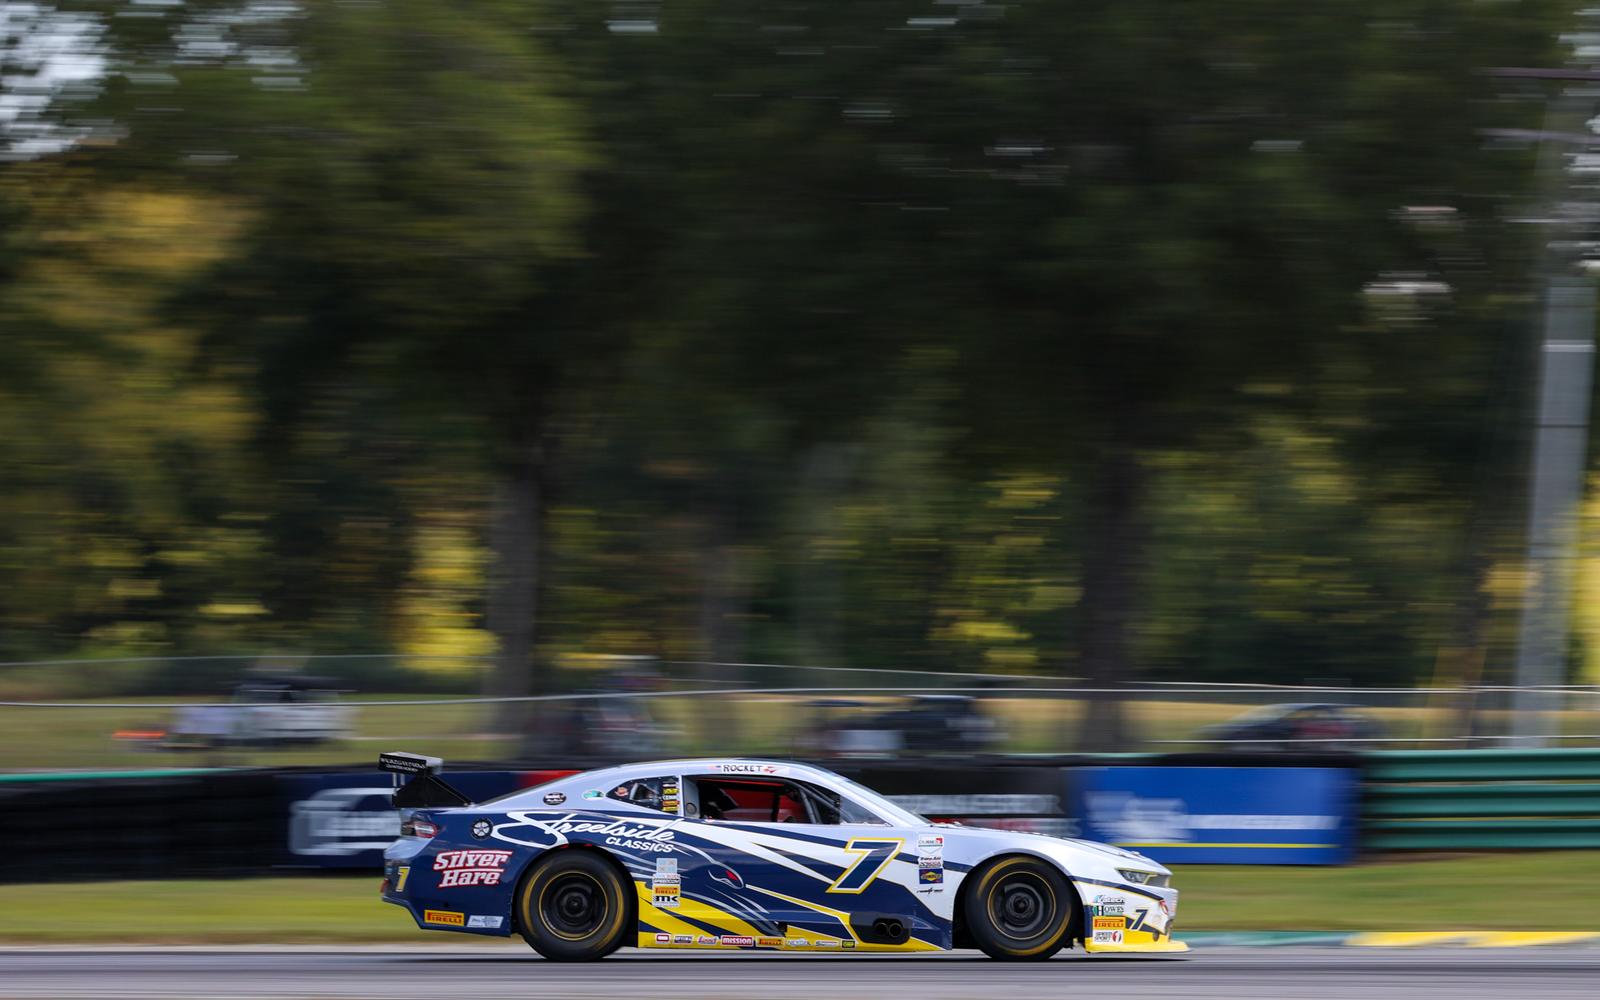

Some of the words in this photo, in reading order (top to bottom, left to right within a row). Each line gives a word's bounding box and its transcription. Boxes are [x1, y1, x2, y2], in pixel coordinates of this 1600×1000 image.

[723, 764, 763, 773] ROCKET
[490, 811, 684, 850] Streetside
[605, 836, 674, 853] CLASSICS
[433, 850, 513, 871] Silver
[825, 837, 906, 895] 7
[438, 868, 504, 889] Hare
[427, 911, 463, 925] PIRELLI
[1094, 918, 1124, 929] PIRELLI
[1129, 908, 1149, 931] 7
[722, 937, 753, 946] mission
